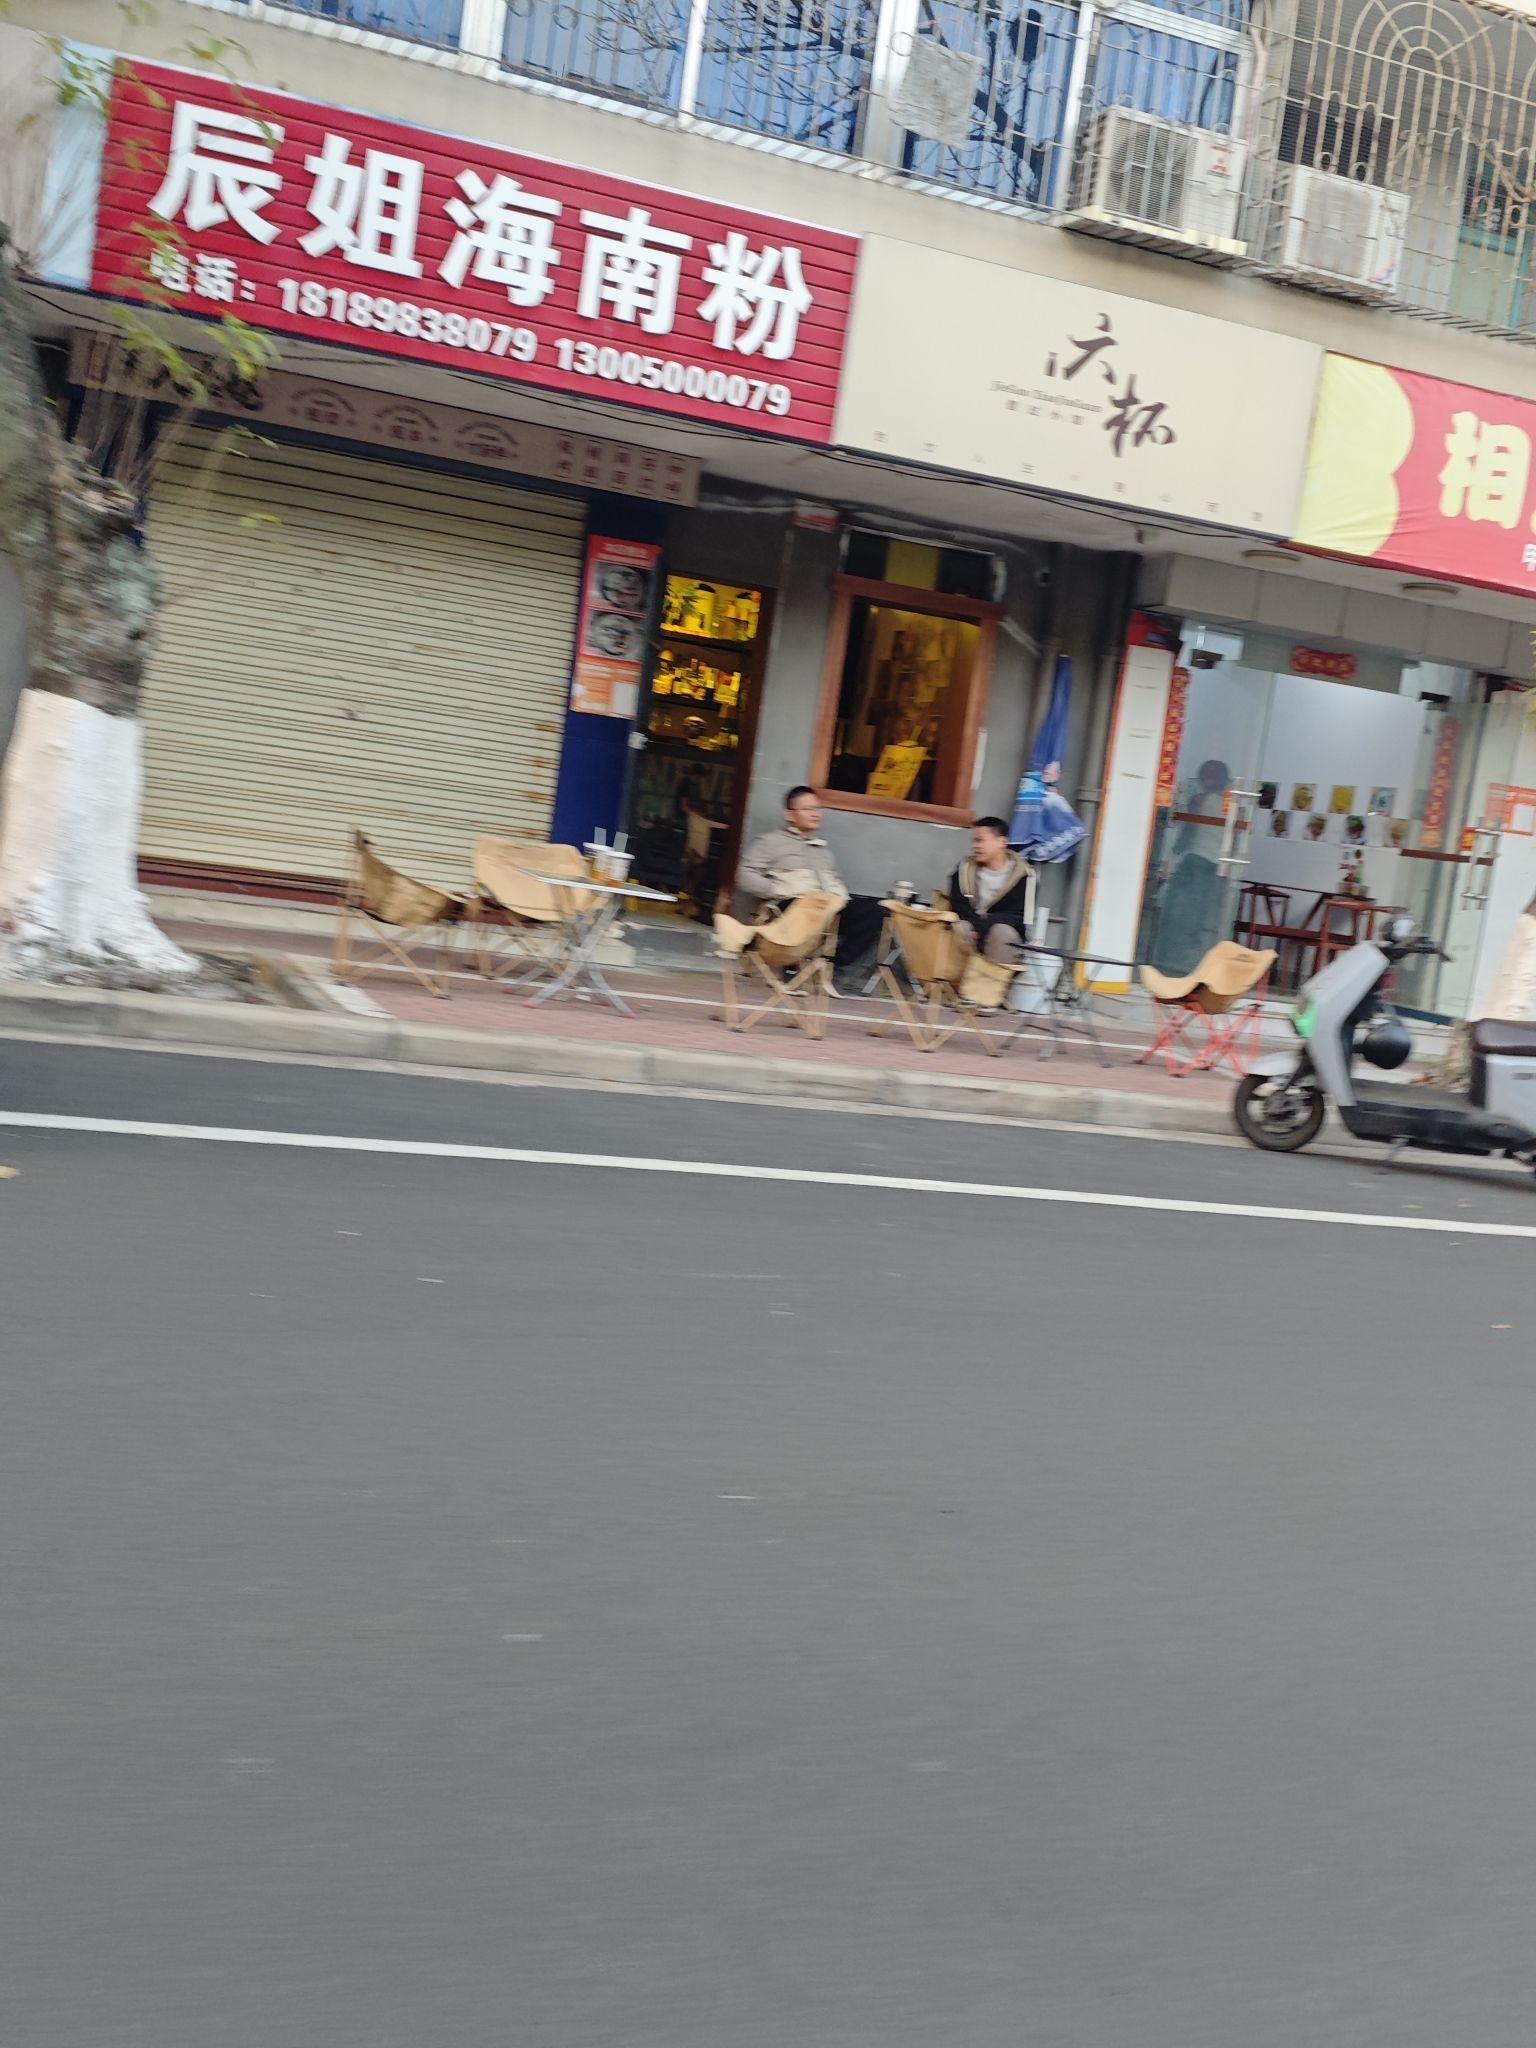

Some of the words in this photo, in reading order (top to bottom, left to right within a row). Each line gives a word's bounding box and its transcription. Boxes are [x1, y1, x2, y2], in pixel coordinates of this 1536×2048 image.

[145, 101, 814, 362] 辰姐海南粉
[277, 278, 539, 363] 18189838079
[553, 337, 793, 417] 13005000079
[1438, 411, 1536, 536] 相
